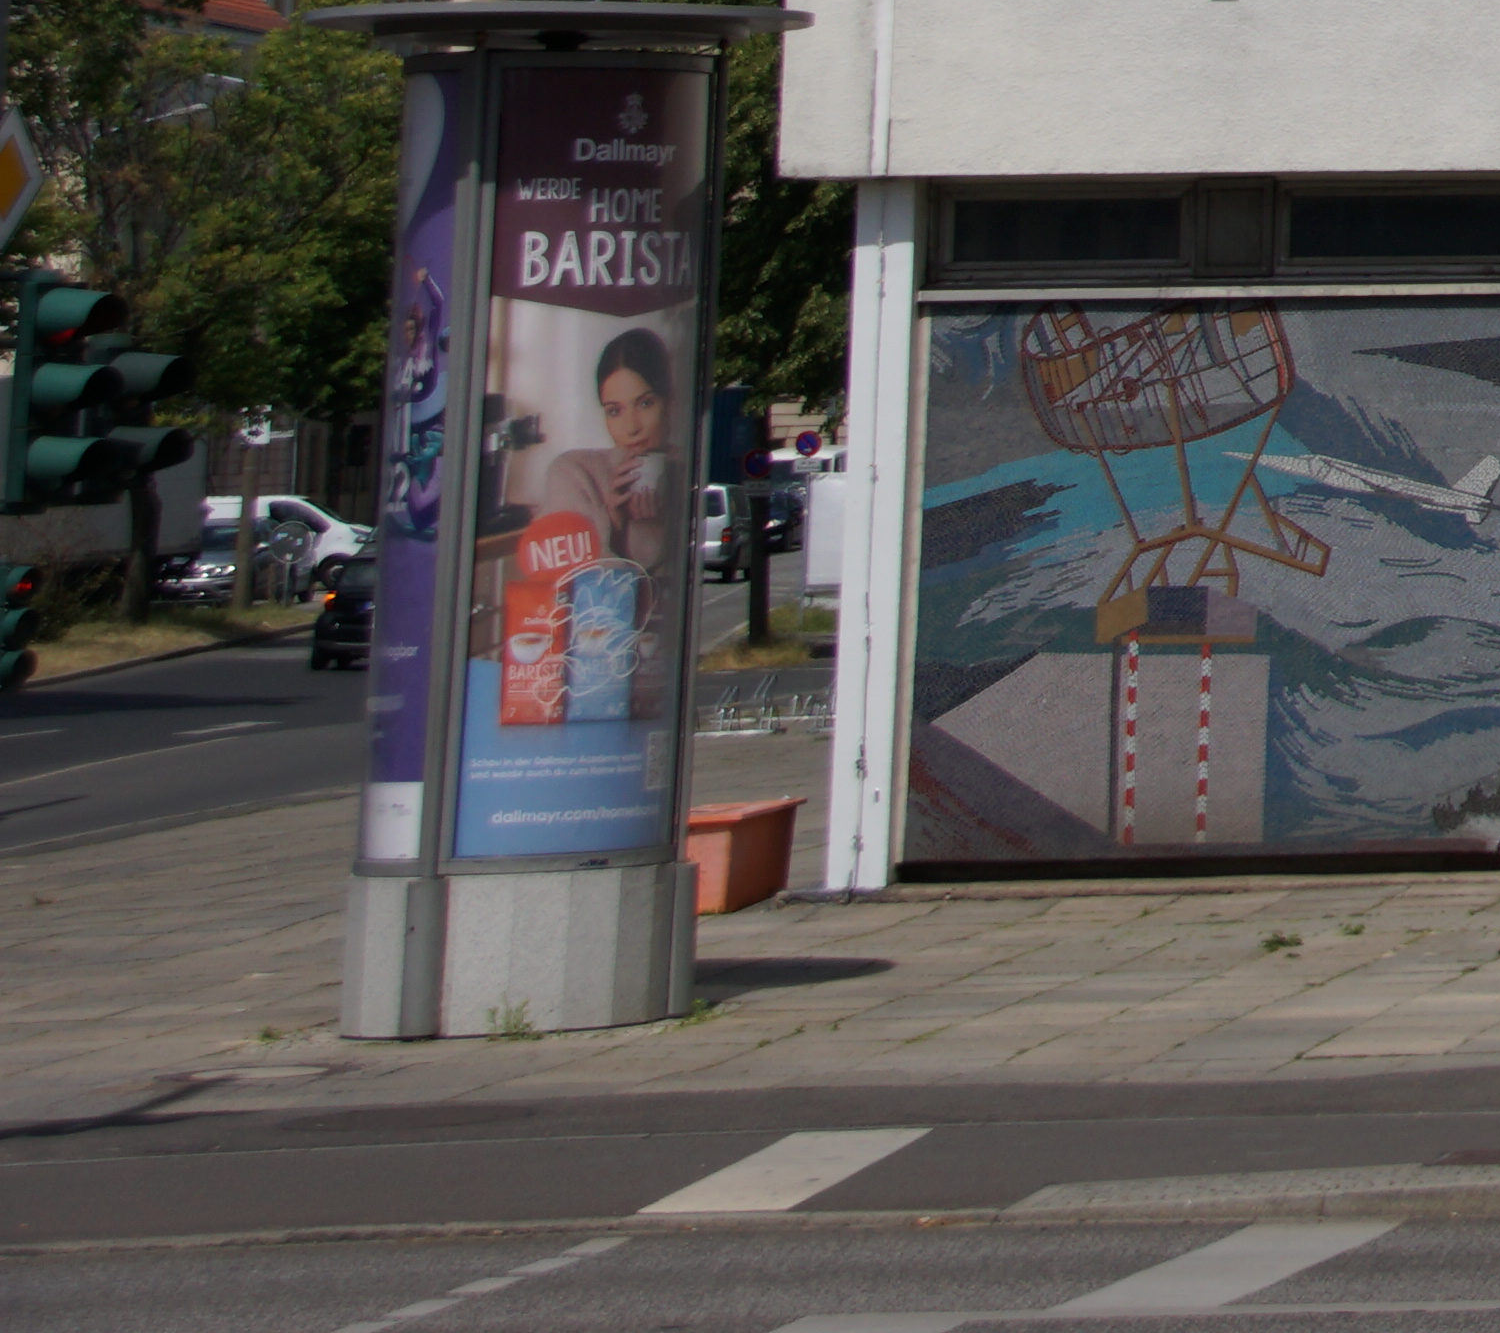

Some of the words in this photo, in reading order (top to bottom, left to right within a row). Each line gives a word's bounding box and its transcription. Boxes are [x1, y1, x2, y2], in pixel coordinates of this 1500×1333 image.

[574, 137, 677, 167] Dallmayr
[517, 177, 583, 201] WERDE
[588, 188, 663, 224] HOME
[520, 229, 693, 287] BARISTA
[529, 530, 593, 572] NEU!
